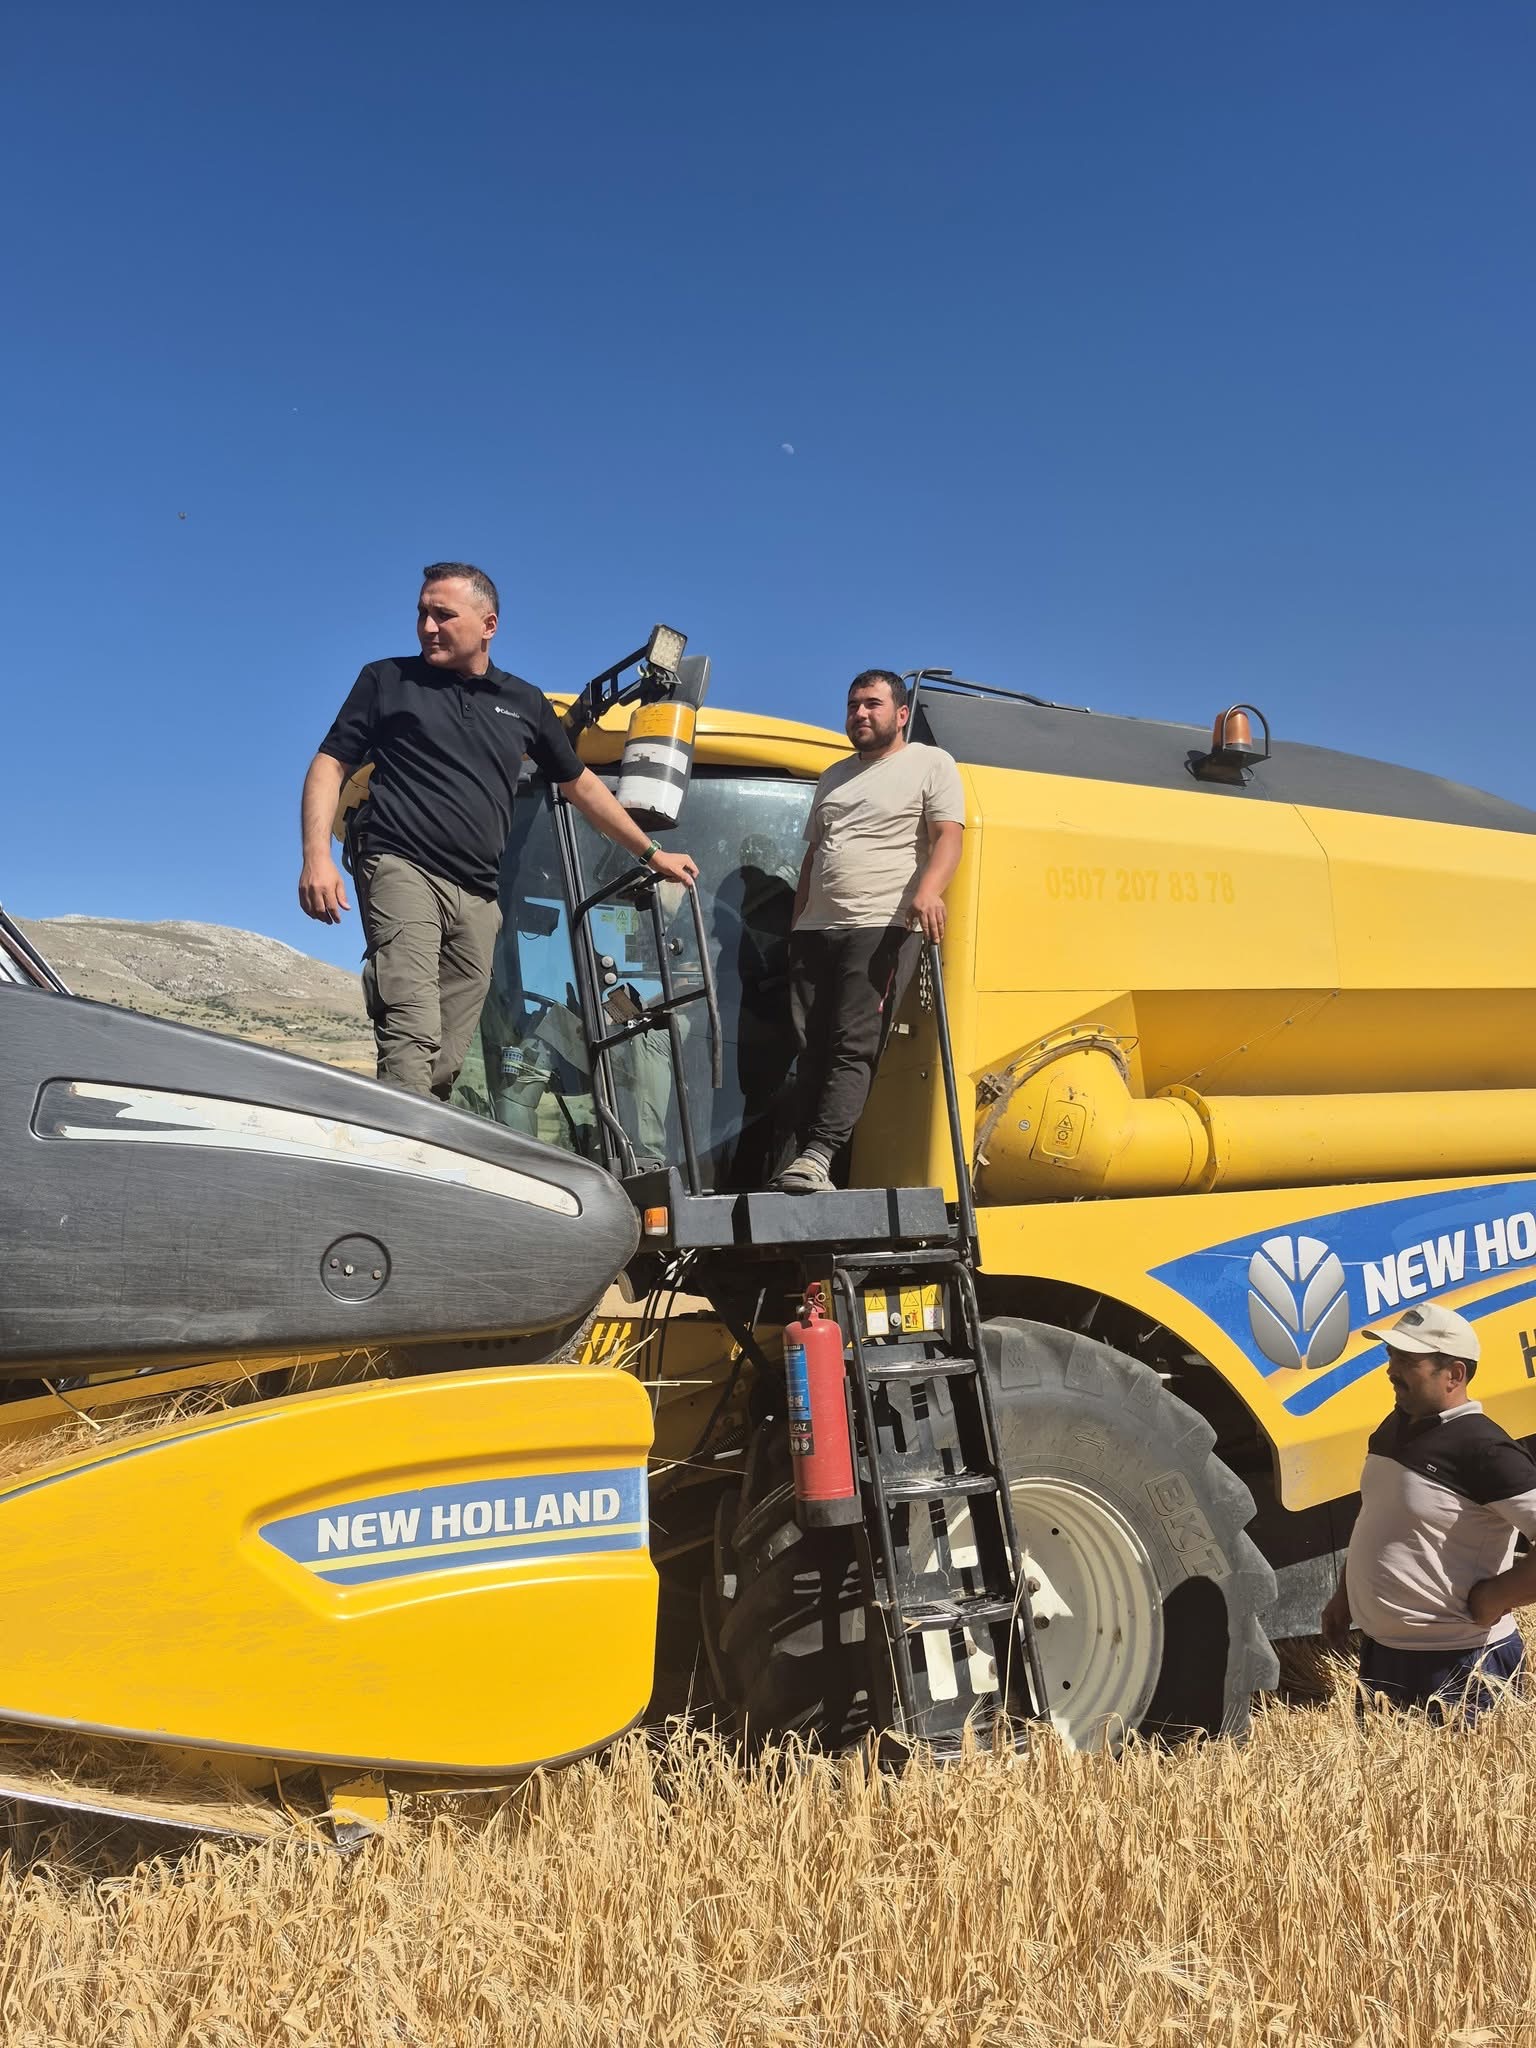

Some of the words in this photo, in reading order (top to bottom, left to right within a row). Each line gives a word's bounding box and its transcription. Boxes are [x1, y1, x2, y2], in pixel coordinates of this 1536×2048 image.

[1044, 867, 1106, 900] 0507
[1115, 868, 1160, 902] 207
[1167, 870, 1199, 903] 83
[1203, 871, 1236, 905] 78
[1362, 1229, 1466, 1316] NEW
[1474, 1211, 1536, 1272] HO
[317, 1507, 421, 1553] NEW
[431, 1487, 620, 1539] HOLLAND
[1151, 1475, 1226, 1577] BKT
